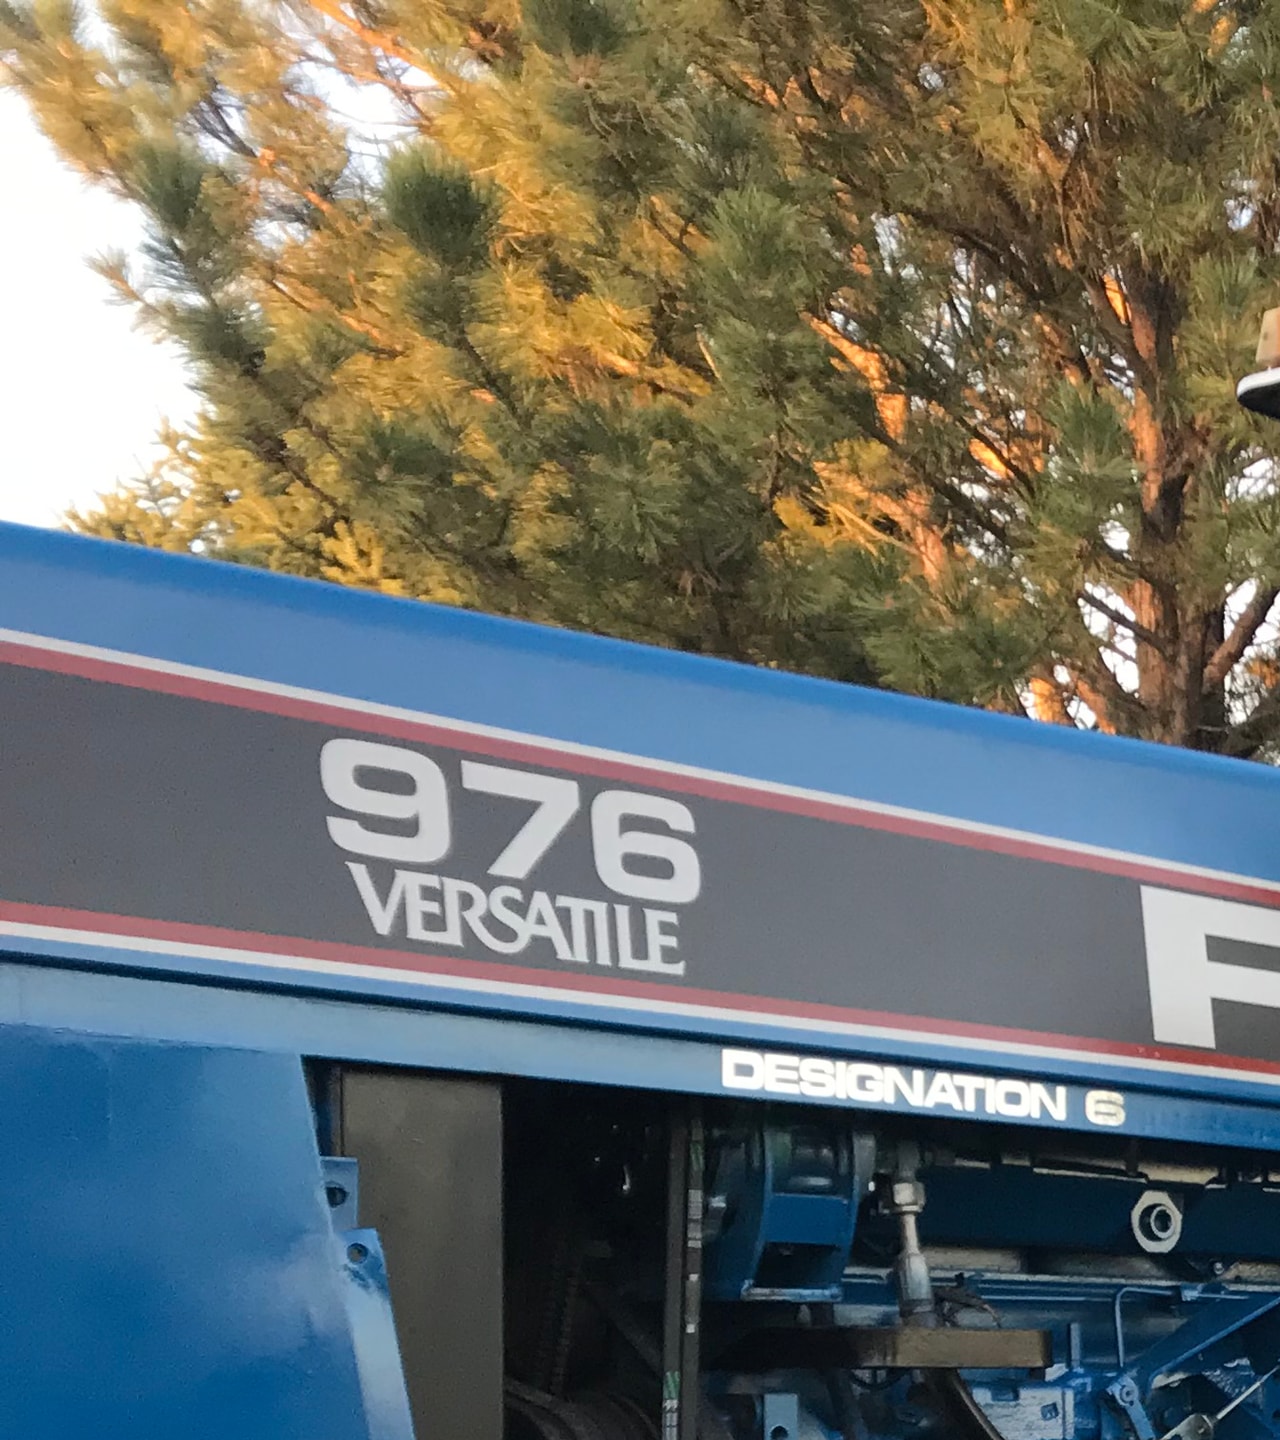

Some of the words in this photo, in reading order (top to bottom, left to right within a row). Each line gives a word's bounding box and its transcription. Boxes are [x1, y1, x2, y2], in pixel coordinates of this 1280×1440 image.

[320, 738, 701, 902] 976
[344, 860, 686, 976] VERSATILE
[721, 1048, 1068, 1121] DESIGNATION
[1085, 1089, 1126, 1127] 6
